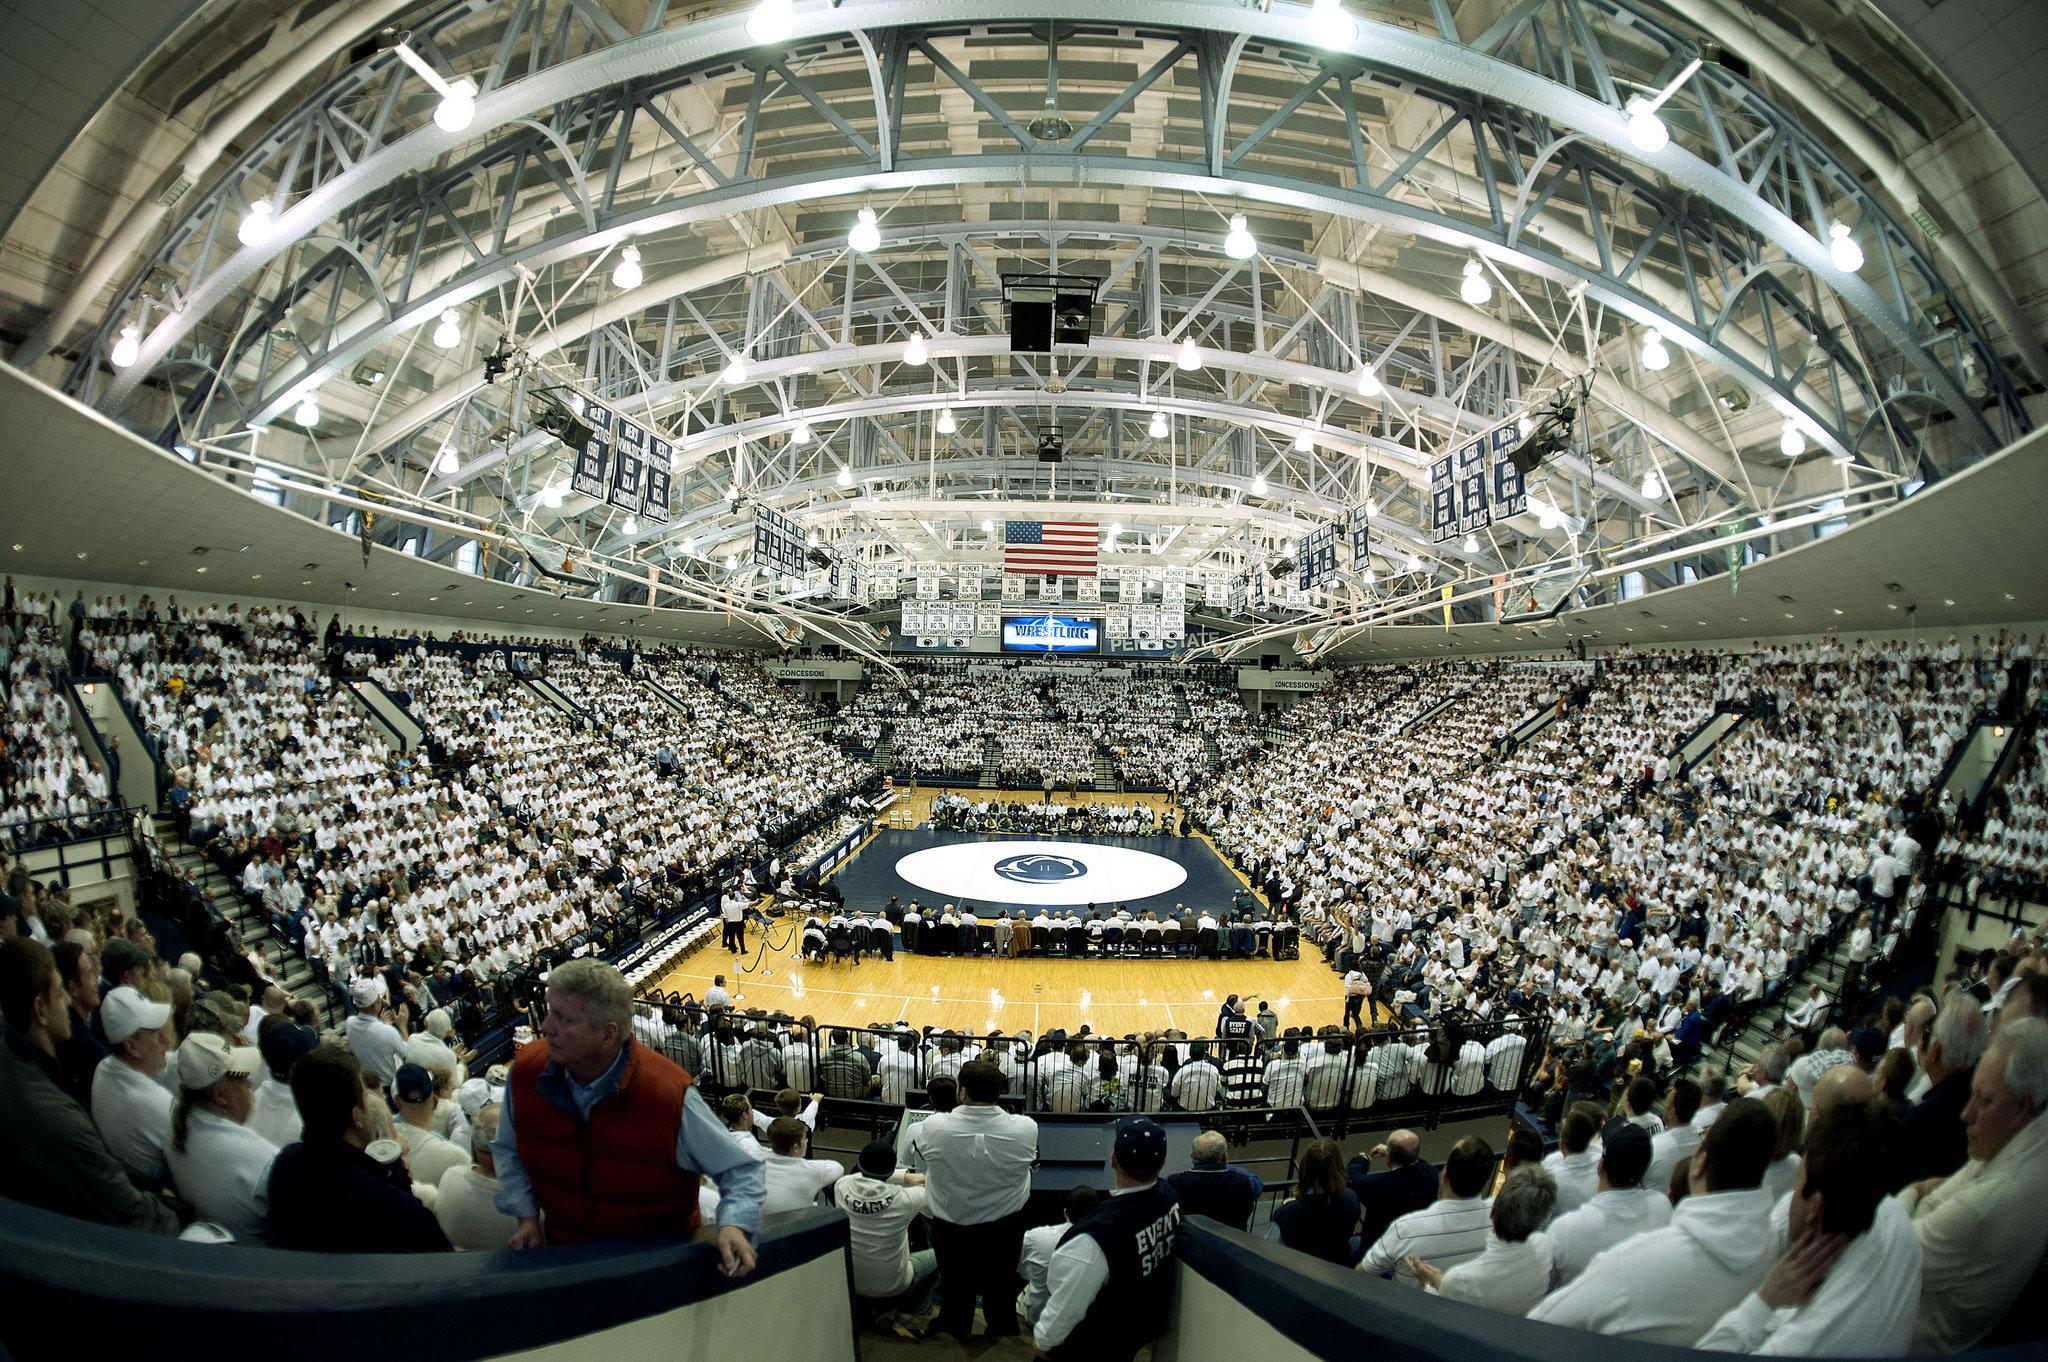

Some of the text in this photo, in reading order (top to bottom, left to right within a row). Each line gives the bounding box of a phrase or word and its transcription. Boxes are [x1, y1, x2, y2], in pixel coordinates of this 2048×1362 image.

[1016, 625, 1088, 639] WRESTLING
[1274, 681, 1319, 689] CONCESSIONS
[1136, 1202, 1180, 1255] EVENT
